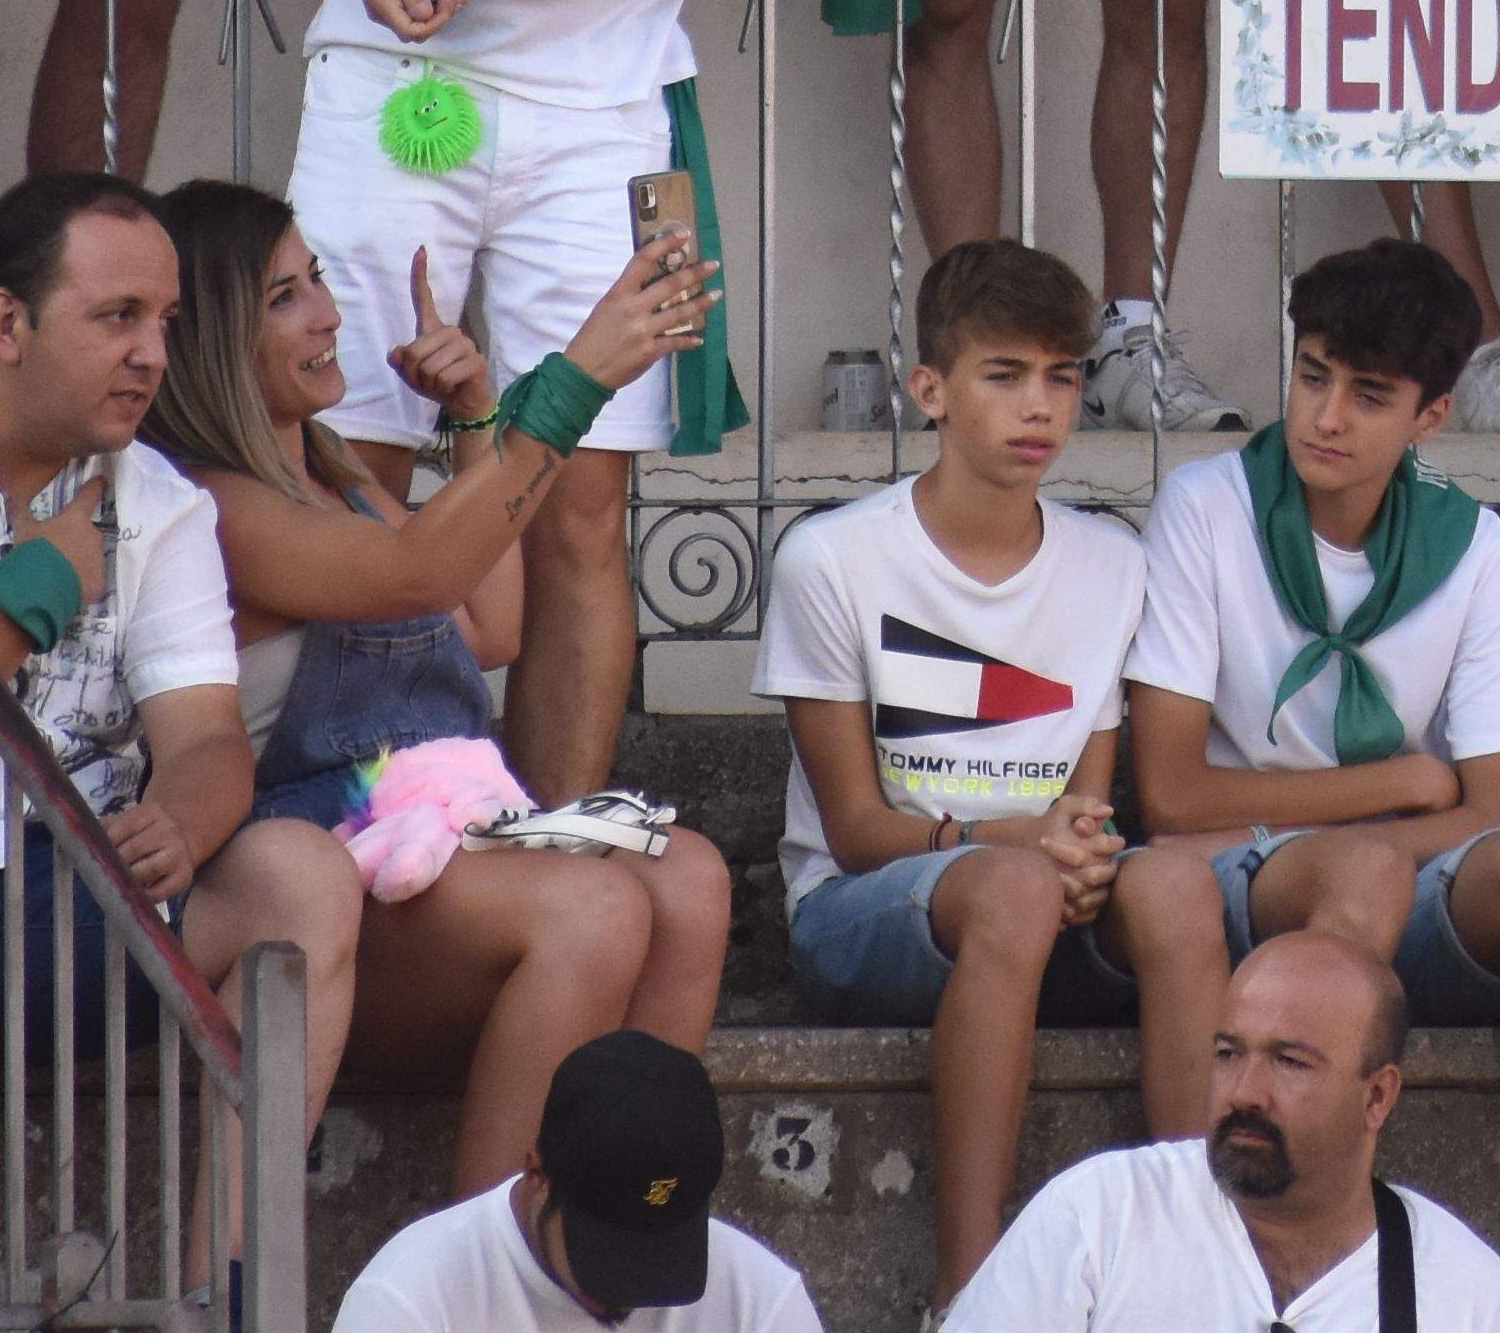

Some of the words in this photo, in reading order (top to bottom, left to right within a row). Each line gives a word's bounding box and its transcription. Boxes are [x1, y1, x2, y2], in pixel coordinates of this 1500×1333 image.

[878, 745, 956, 775] TOMMY
[967, 759, 1070, 780] HILFIGER
[772, 1117, 816, 1172] 3
